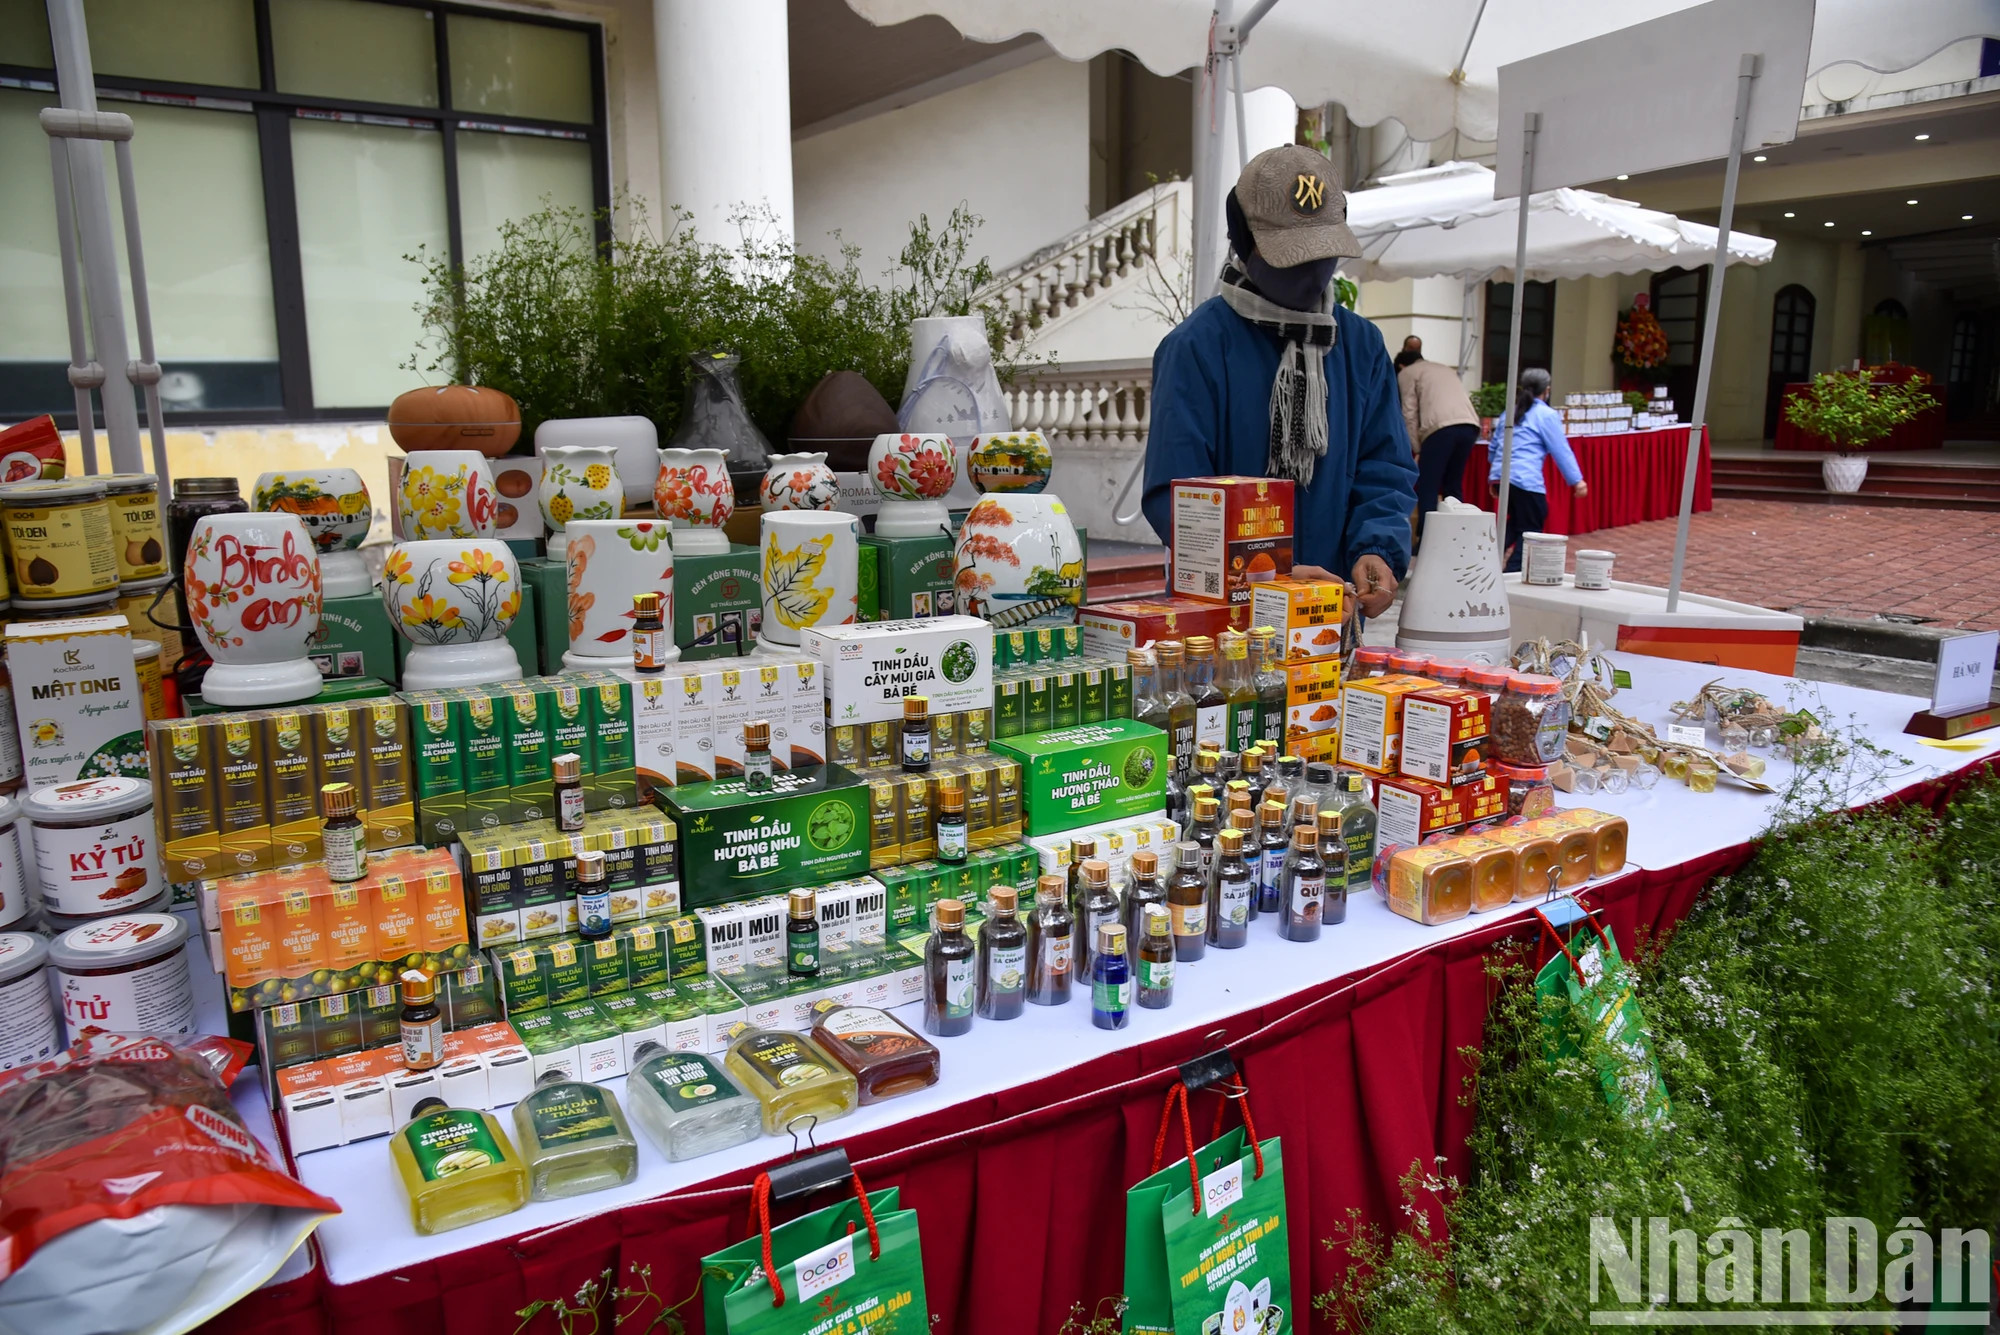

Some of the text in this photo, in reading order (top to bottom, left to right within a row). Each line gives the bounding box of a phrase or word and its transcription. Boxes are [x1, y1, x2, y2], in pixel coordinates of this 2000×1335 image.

[1295, 174, 1326, 210] NY
[1242, 507, 1263, 522] TINH
[1247, 541, 1275, 550] CURCUMIN
[1296, 607, 1310, 616] TINH
[53, 663, 95, 674] KochiGold
[872, 652, 929, 671] TINH DẦU
[864, 667, 936, 687] CÂY MÙI GIÀ
[32, 677, 120, 700] MẬT ONG
[883, 684, 900, 699] BÀ
[1237, 709, 1253, 724] TINH
[1264, 712, 1281, 727] TINH
[1175, 726, 1193, 742] TINH
[384, 751, 401, 759] JAVA
[289, 764, 307, 772] JAVA
[1062, 762, 1111, 784] TINH DẦU
[1052, 773, 1120, 800] HƯƠNG THẢO
[1071, 793, 1086, 809] BÀ
[723, 819, 791, 844] TINH DẦU
[70, 836, 146, 872] KỶ TỬ
[714, 836, 801, 862] HƯƠNG NHU
[821, 899, 850, 922] MÙI
[856, 893, 884, 914] MÙI
[711, 920, 743, 944] MÙI
[749, 914, 780, 937] MÙI
[1207, 1175, 1239, 1201] OCOP
[802, 1252, 848, 1282] OCOP
[1181, 1267, 1200, 1289] TINH
[1244, 1225, 1263, 1245] TINH
[846, 1321, 857, 1334] &
[858, 1303, 886, 1327] TINH
